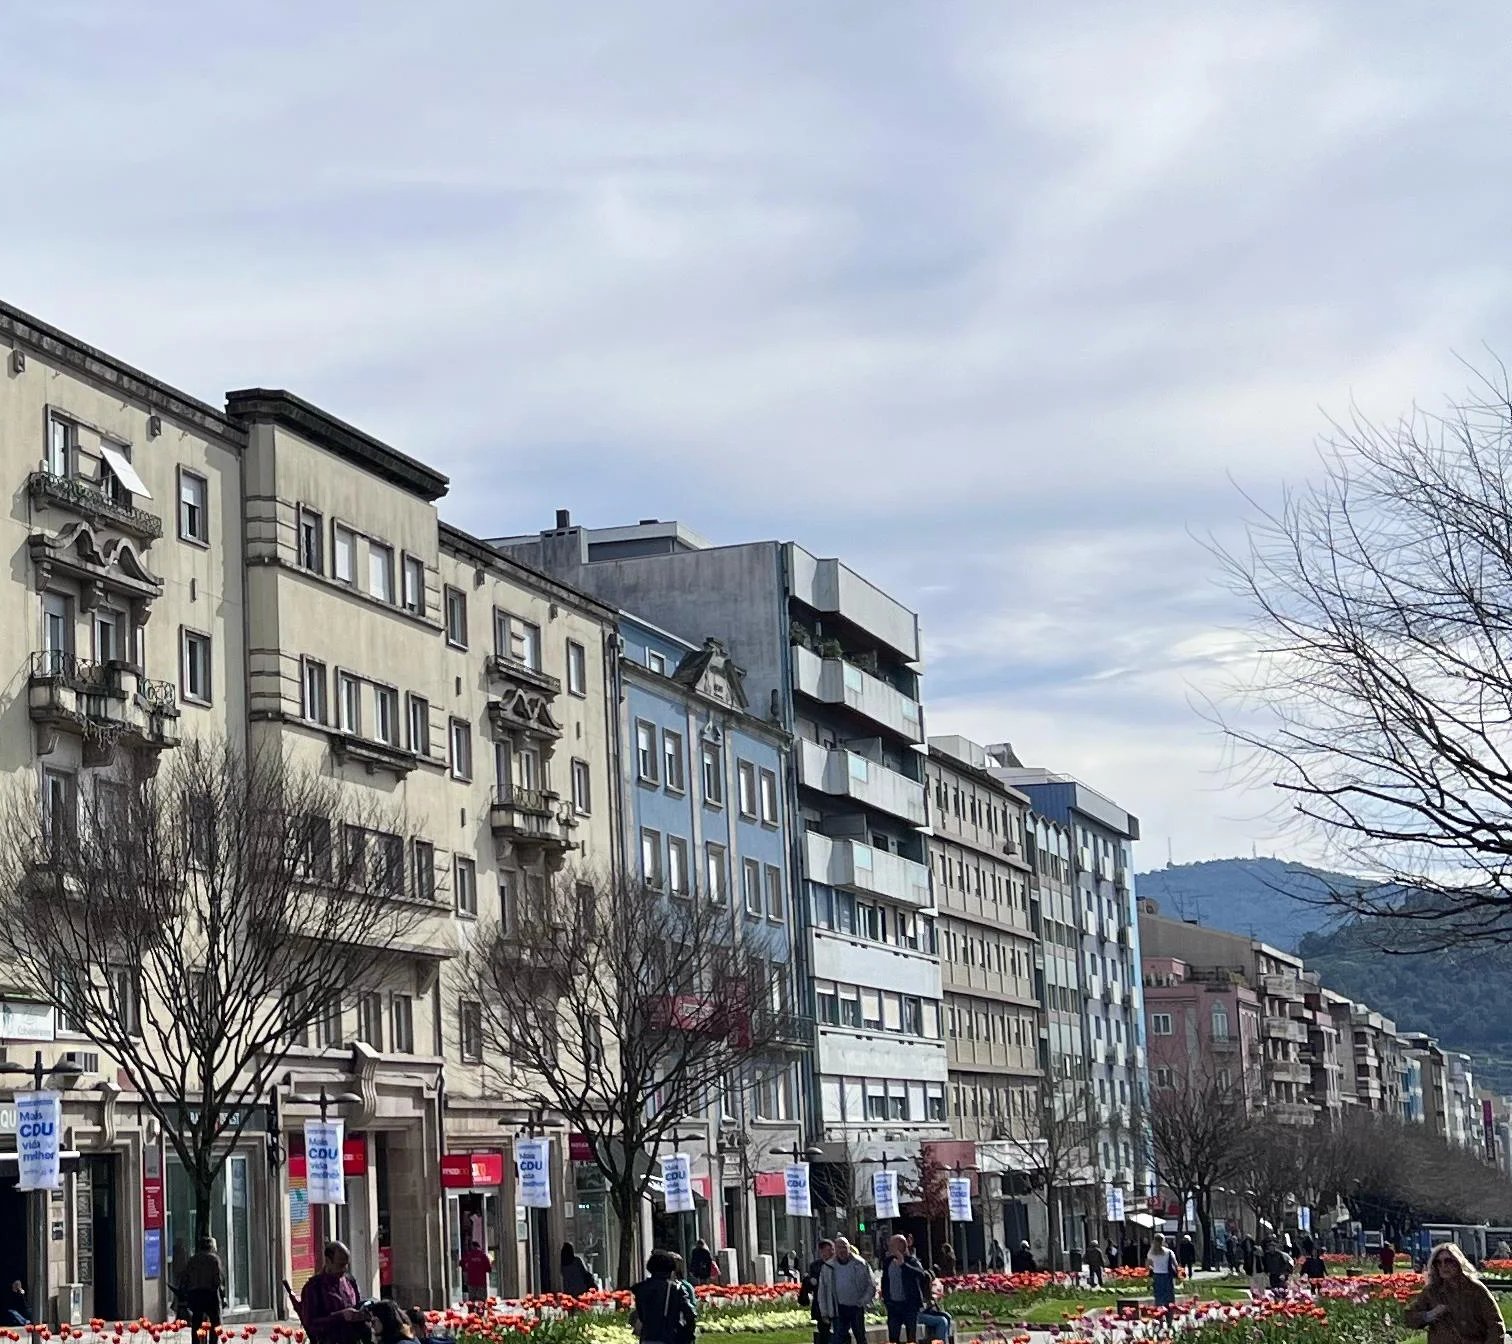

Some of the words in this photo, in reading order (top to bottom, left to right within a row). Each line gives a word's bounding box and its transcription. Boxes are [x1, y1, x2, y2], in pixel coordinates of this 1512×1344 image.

[19, 1122, 54, 1138] CDU
[308, 1148, 338, 1160] CDU
[520, 1161, 543, 1171] CDU
